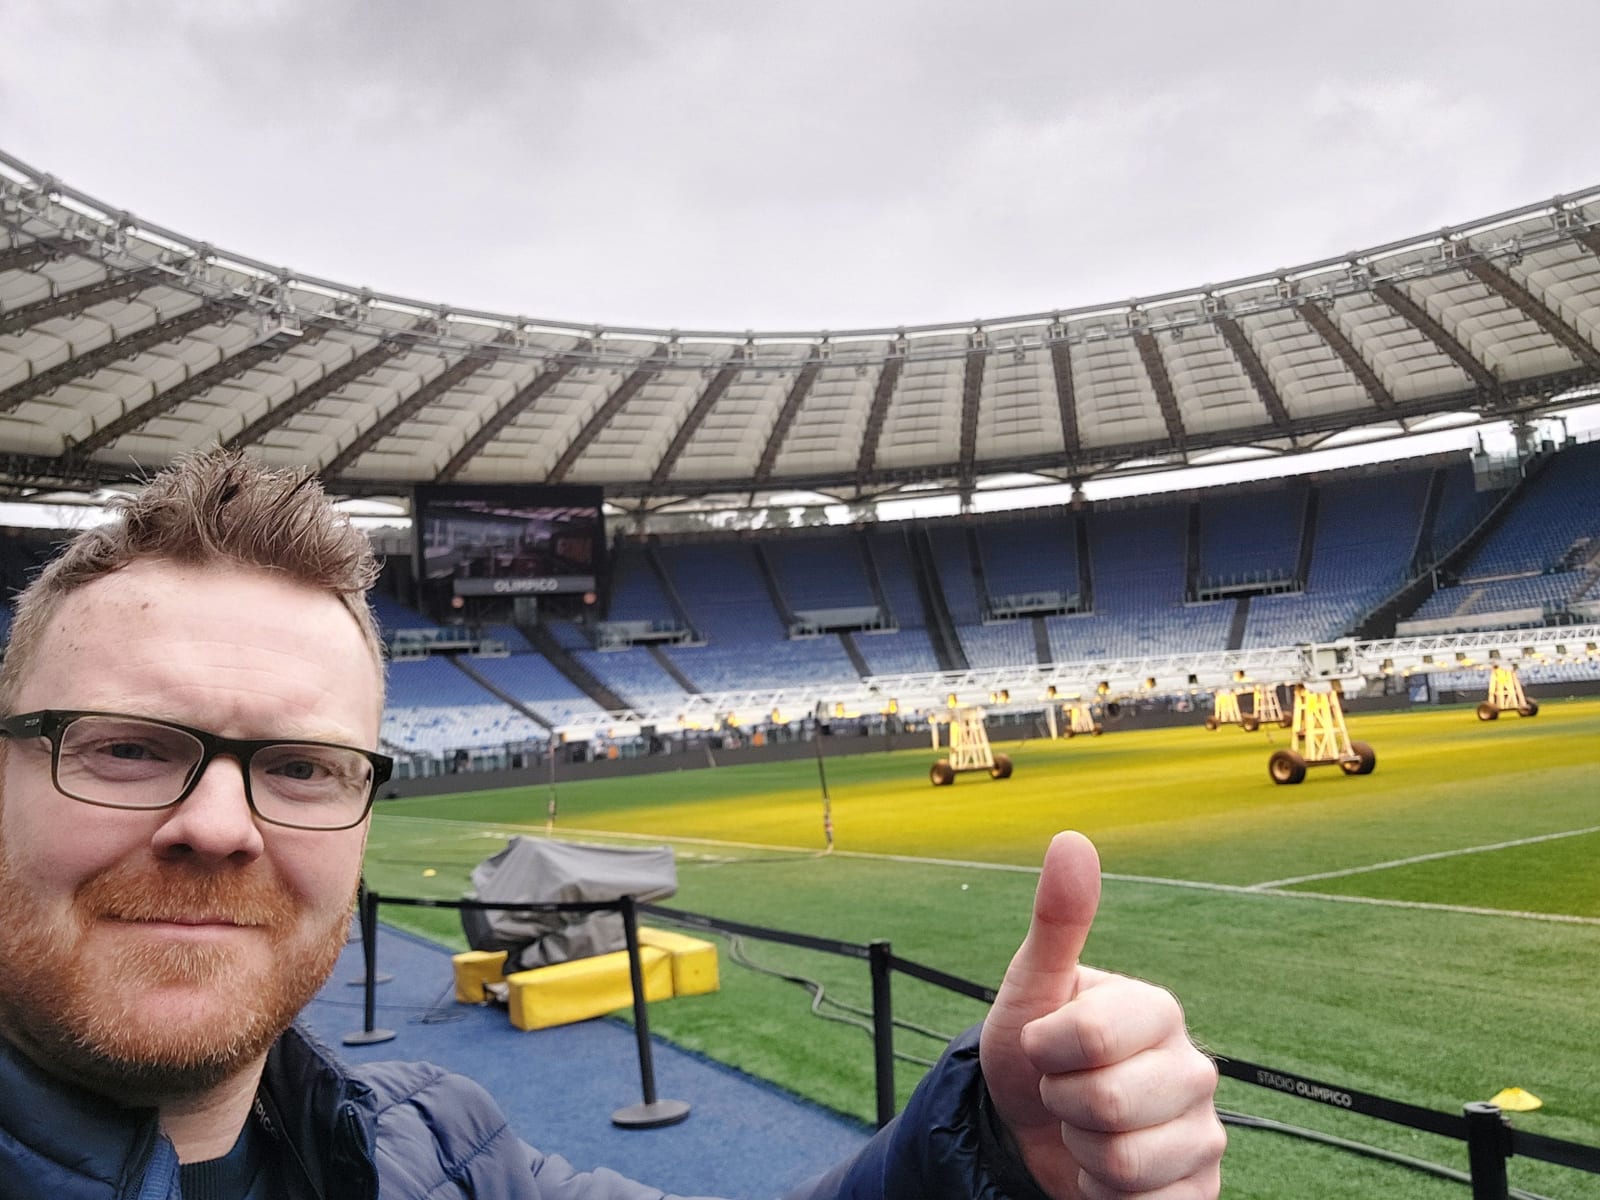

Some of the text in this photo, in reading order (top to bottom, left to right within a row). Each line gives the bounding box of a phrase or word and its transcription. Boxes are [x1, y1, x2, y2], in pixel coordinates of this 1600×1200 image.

[494, 579, 558, 592] OLIMPICO
[1257, 1070, 1353, 1107] STADIO OLIMPICO
